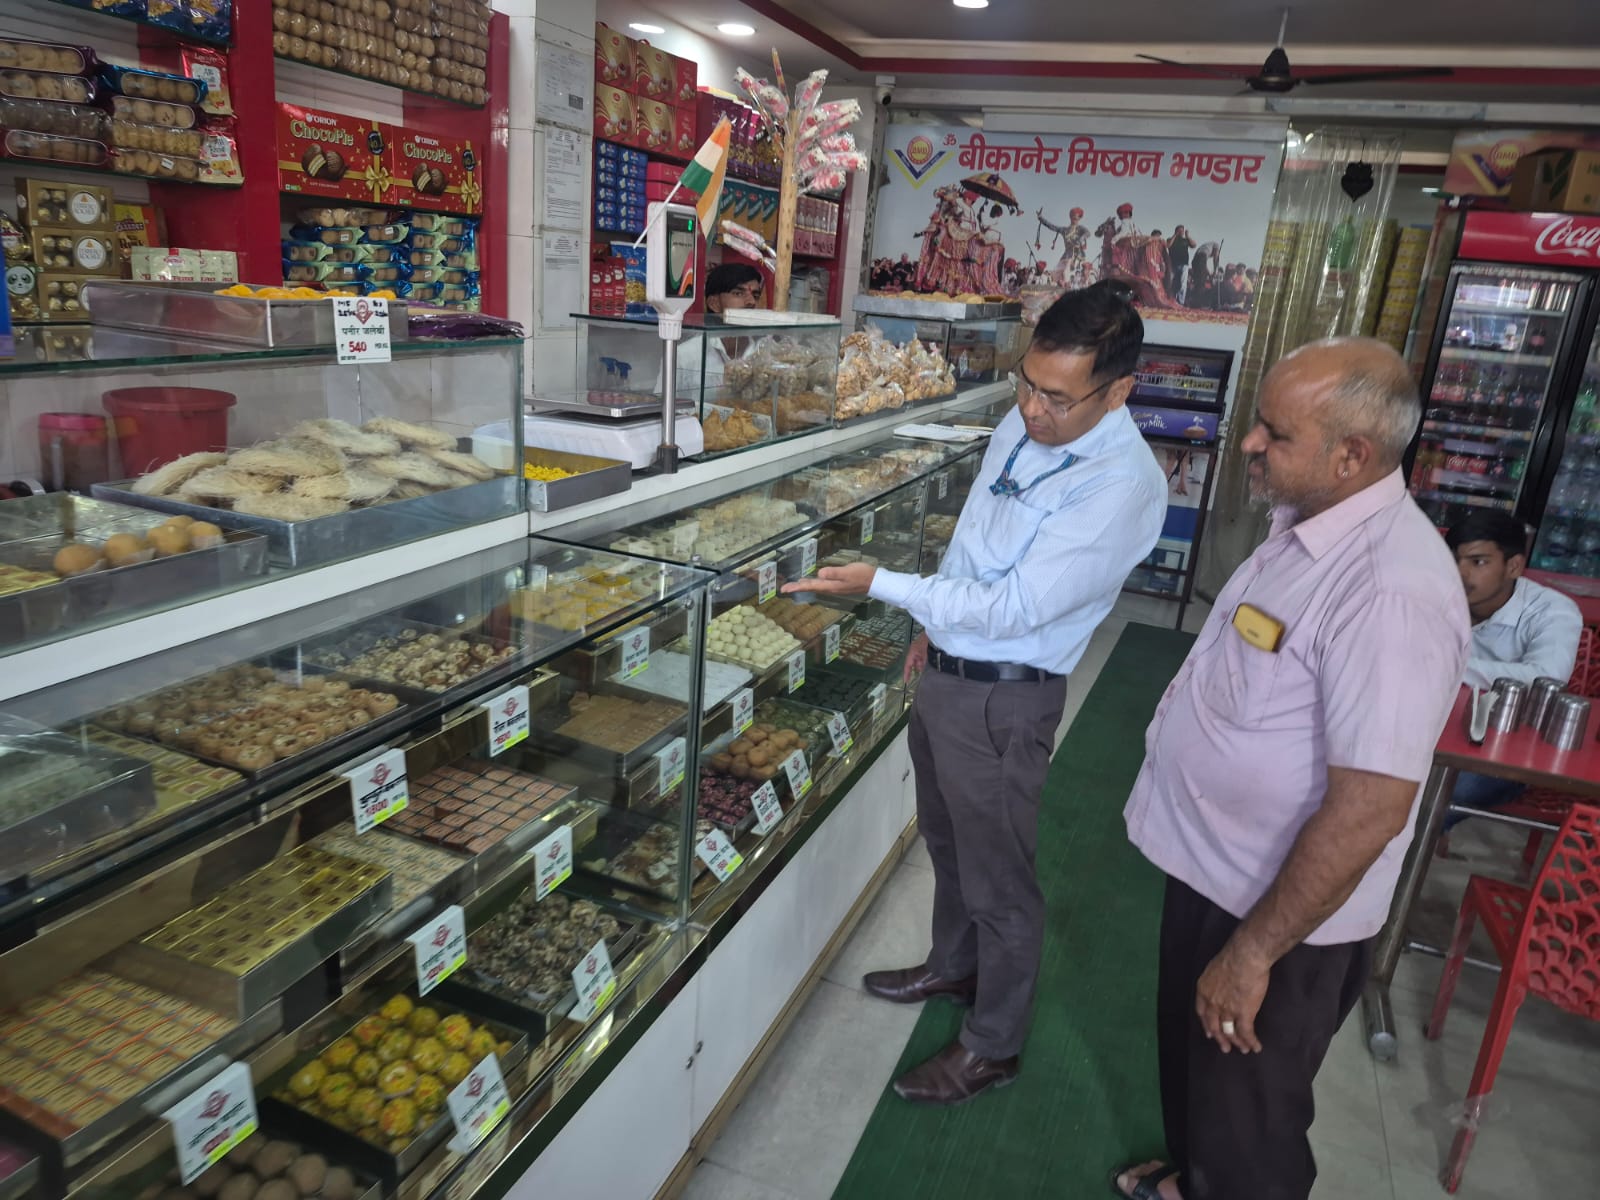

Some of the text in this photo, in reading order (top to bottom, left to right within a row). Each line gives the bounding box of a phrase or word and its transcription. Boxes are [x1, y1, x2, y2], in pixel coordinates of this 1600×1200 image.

[958, 132, 1265, 184] बीकानेर मिष्ठान भण्डार
[349, 340, 367, 353] 540
